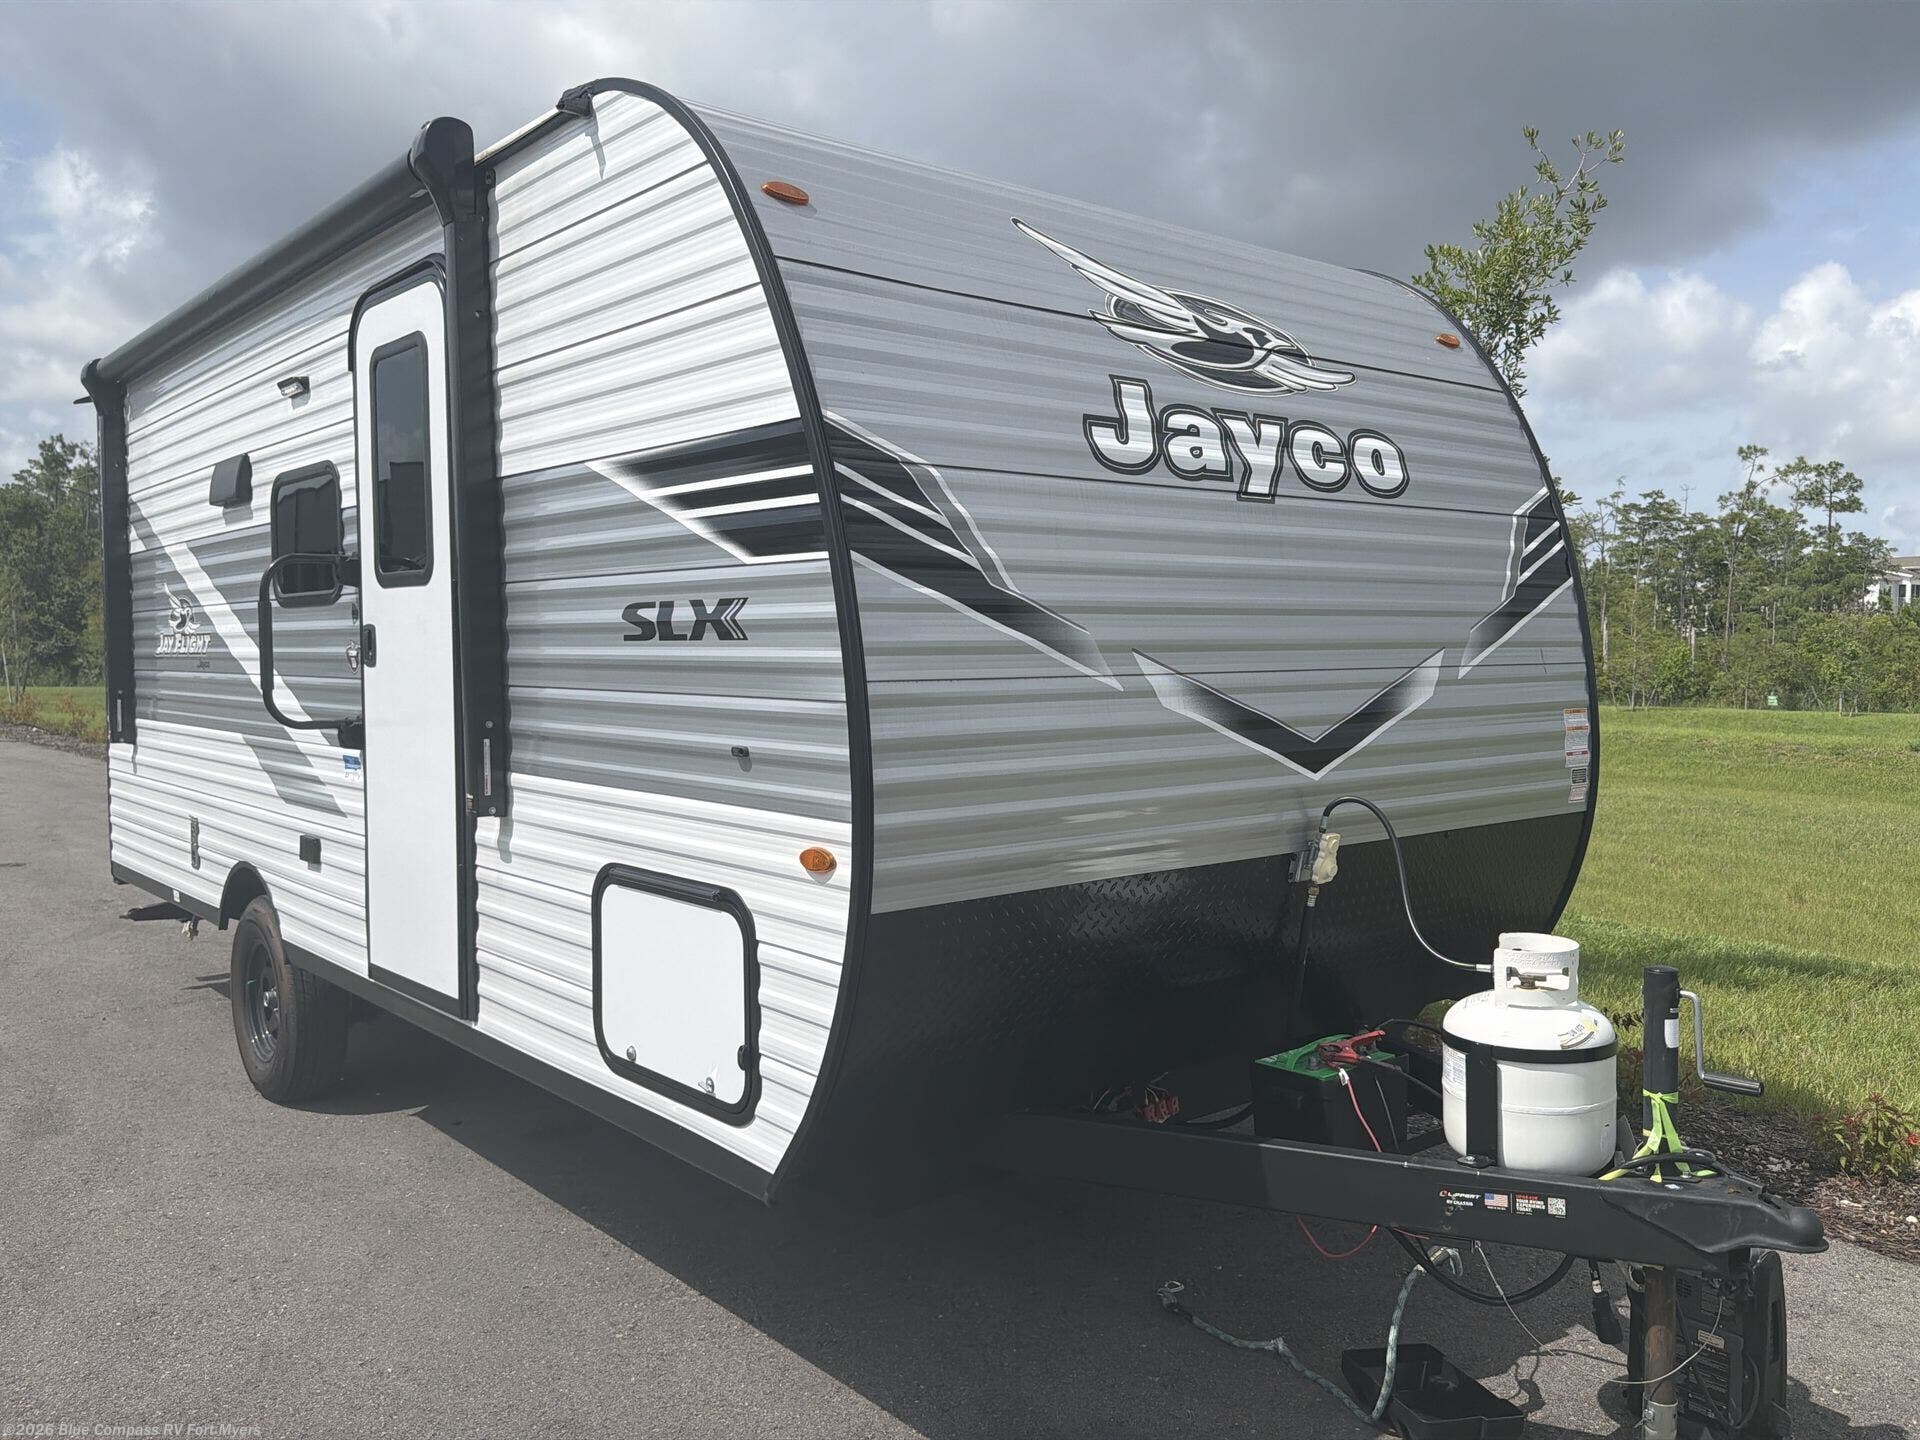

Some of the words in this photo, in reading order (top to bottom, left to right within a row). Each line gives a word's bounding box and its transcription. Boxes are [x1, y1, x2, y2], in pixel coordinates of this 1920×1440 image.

[1082, 373, 1410, 504] Jayco
[621, 597, 749, 642] SLX
[154, 632, 174, 657] JAY
[174, 631, 211, 657] FLIGHT
[1447, 1191, 1481, 1200] LIPPERT
